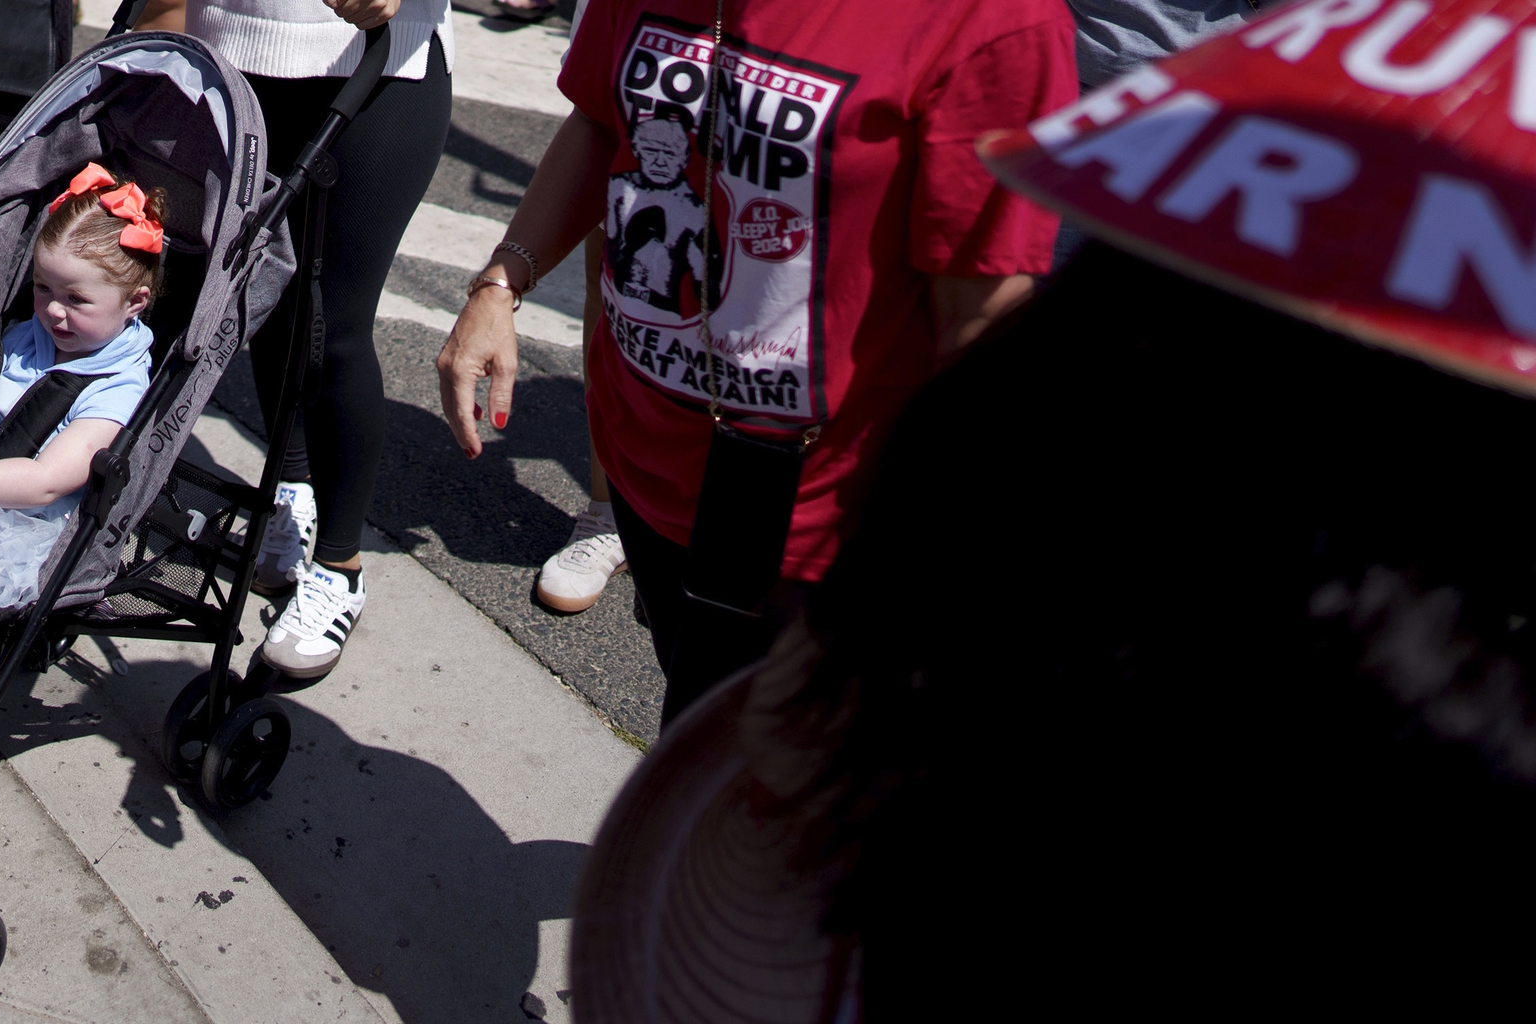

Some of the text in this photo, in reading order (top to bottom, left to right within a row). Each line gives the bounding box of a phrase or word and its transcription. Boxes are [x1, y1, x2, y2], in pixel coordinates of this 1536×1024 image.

[644, 33, 712, 63] NEVER
[248, 136, 257, 153] Jeep
[247, 160, 255, 177] DELTA
[243, 177, 253, 203] CHILDREN
[752, 206, 781, 222] K.O.
[729, 216, 813, 239] SLEEPY JOE
[751, 235, 793, 255] 2024
[214, 338, 238, 368] plus
[603, 295, 660, 351] MAKE
[666, 338, 800, 388] AMERICA
[680, 365, 798, 410] AGAIN!
